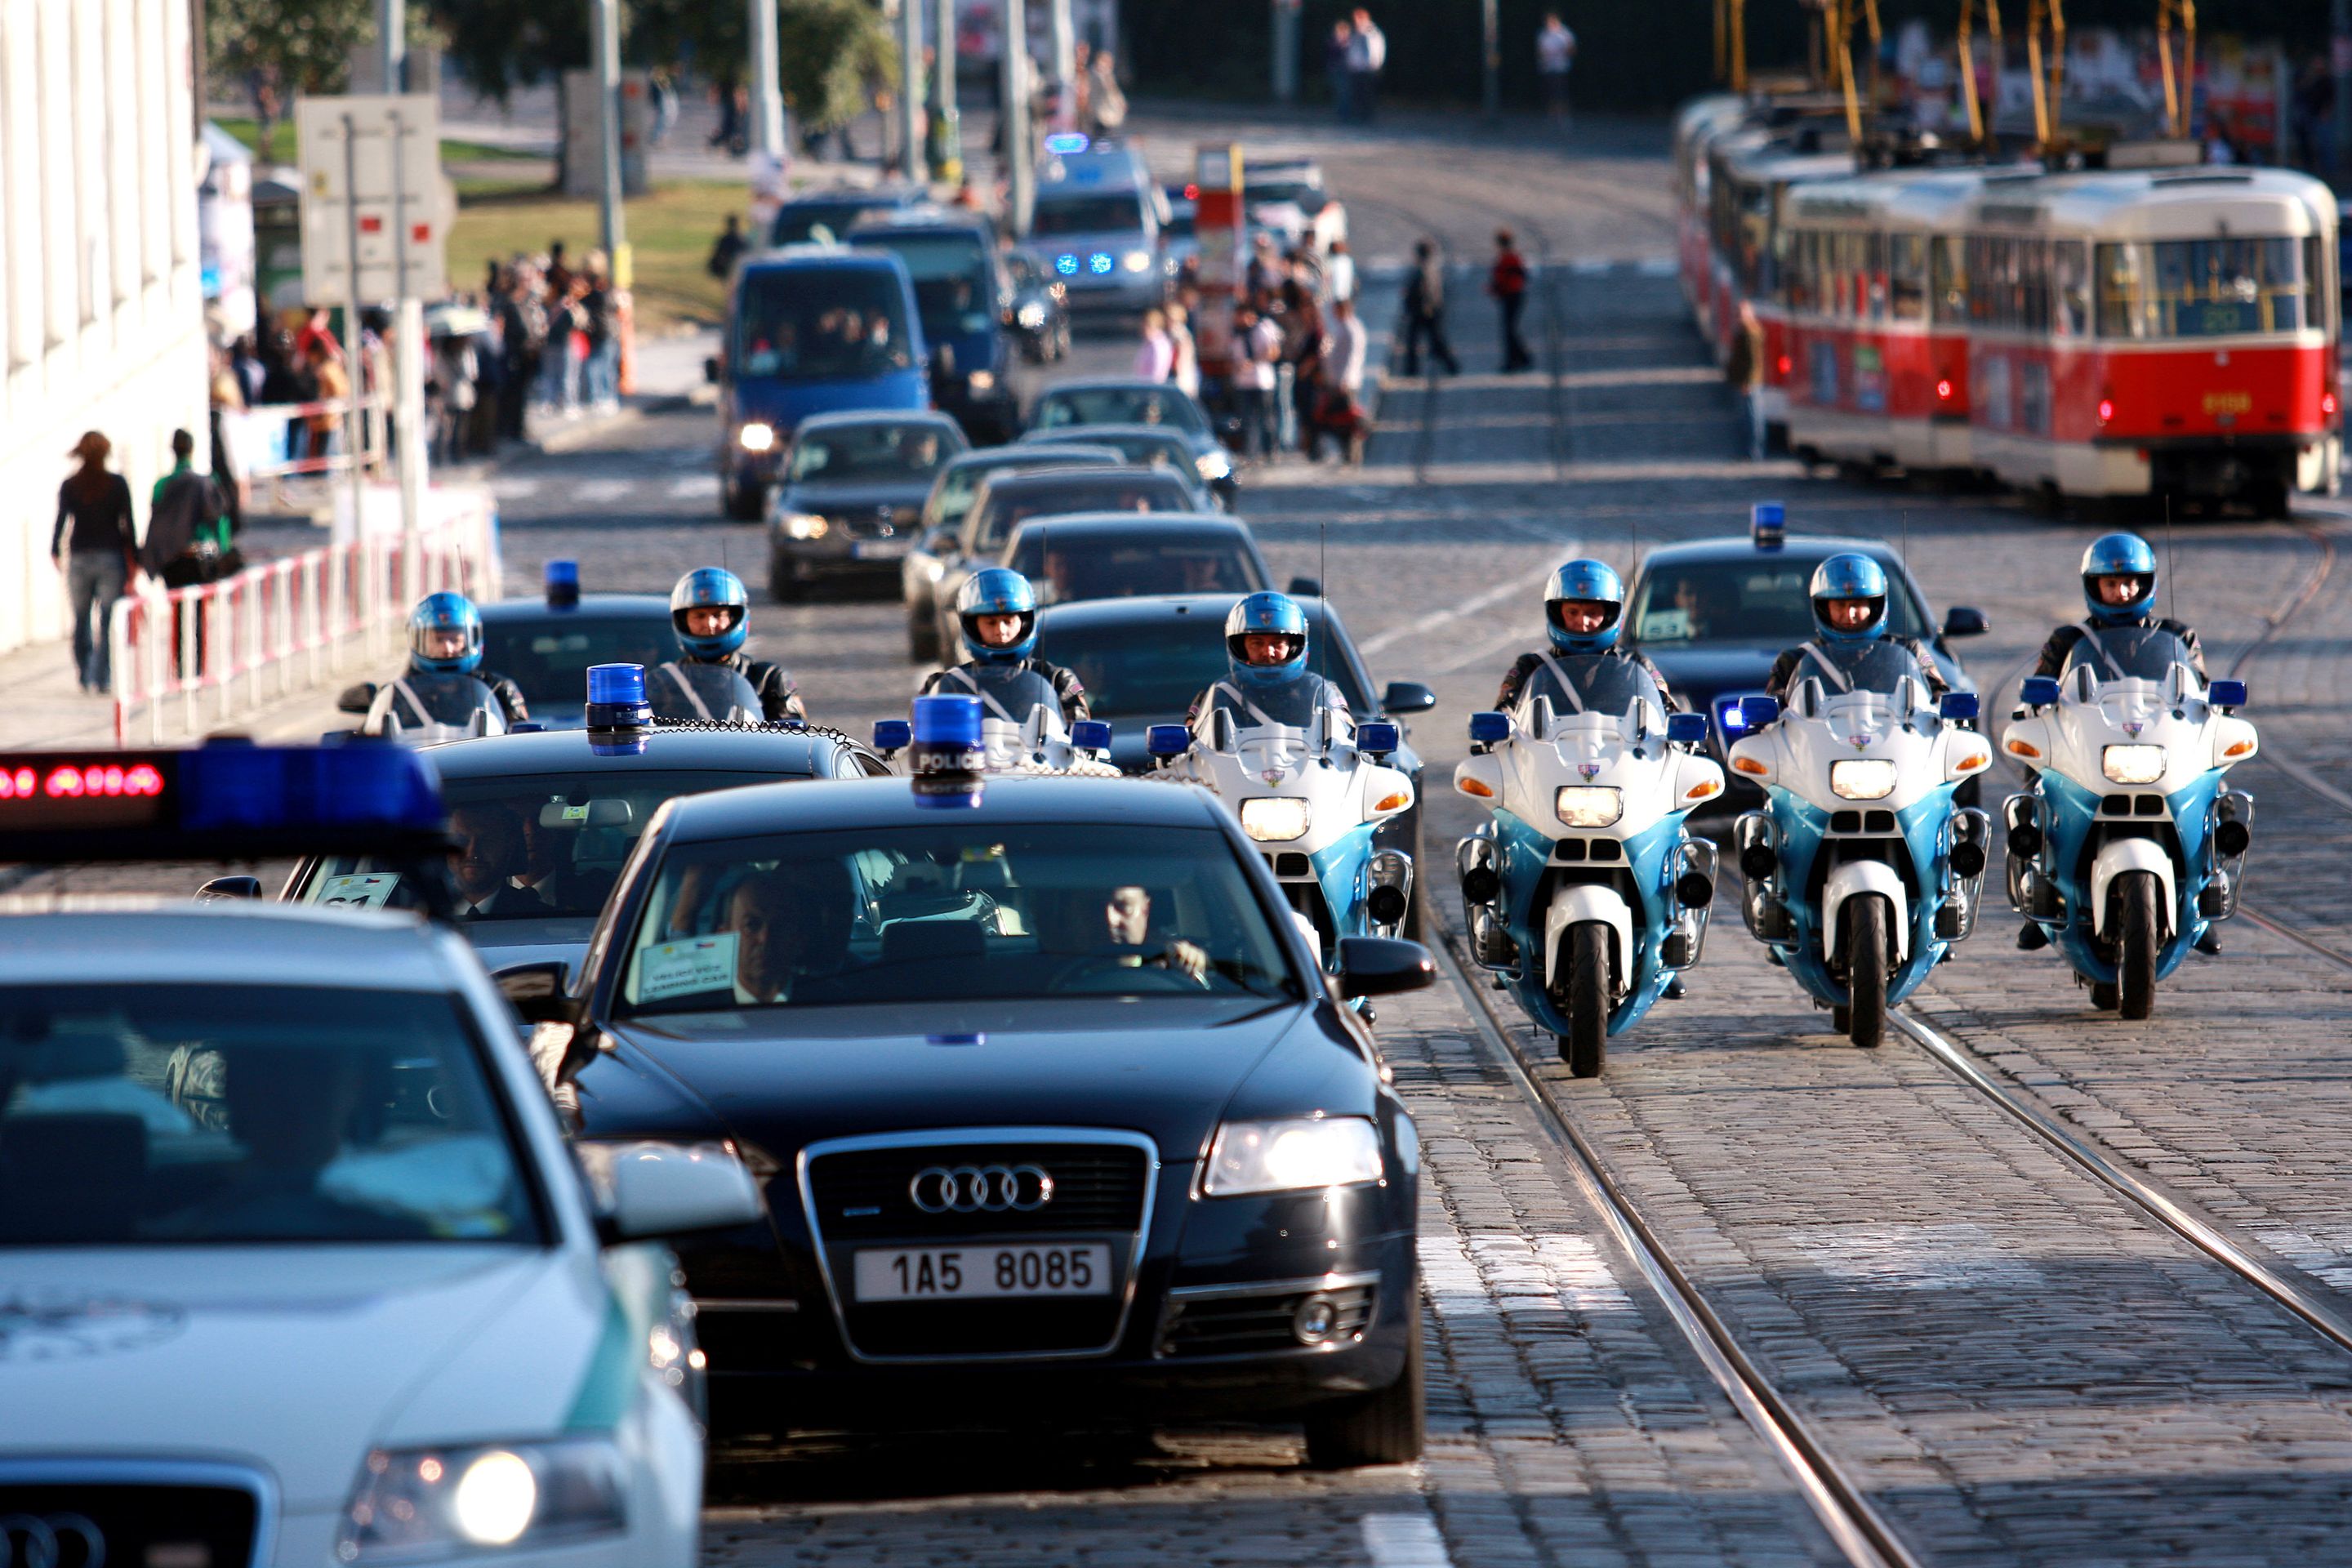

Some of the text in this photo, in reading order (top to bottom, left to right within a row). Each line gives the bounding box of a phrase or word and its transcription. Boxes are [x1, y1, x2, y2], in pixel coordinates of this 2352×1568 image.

[919, 752, 986, 770] POLICE
[892, 1250, 1092, 1294] 1A5 8085
